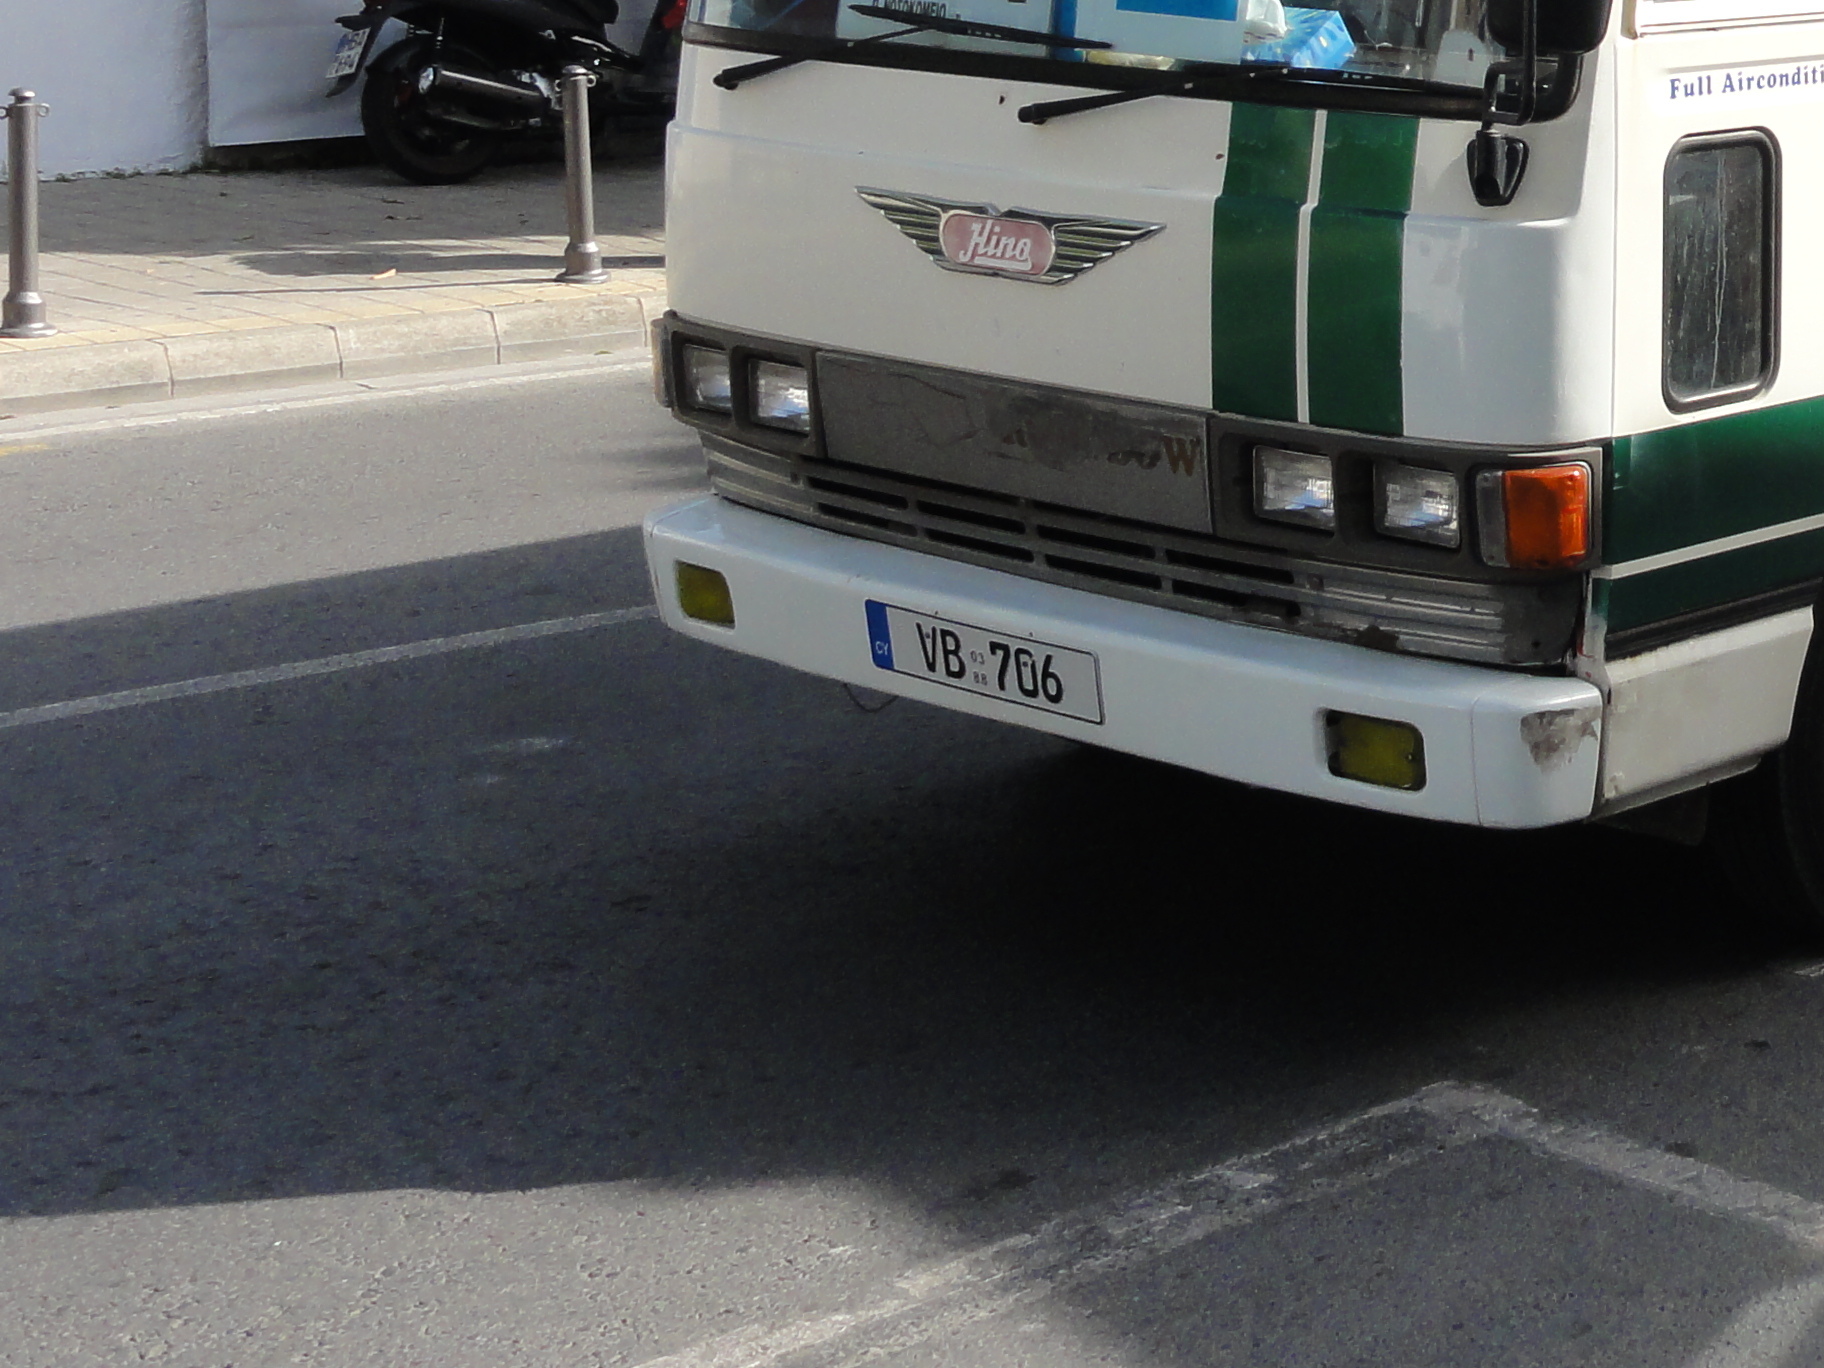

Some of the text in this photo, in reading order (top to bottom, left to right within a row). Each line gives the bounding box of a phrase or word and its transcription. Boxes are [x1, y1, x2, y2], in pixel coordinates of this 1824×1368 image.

[1668, 74, 1713, 100] Full
[958, 217, 1033, 269] Hino
[875, 640, 889, 656] CY
[915, 621, 1064, 705] VB 706
